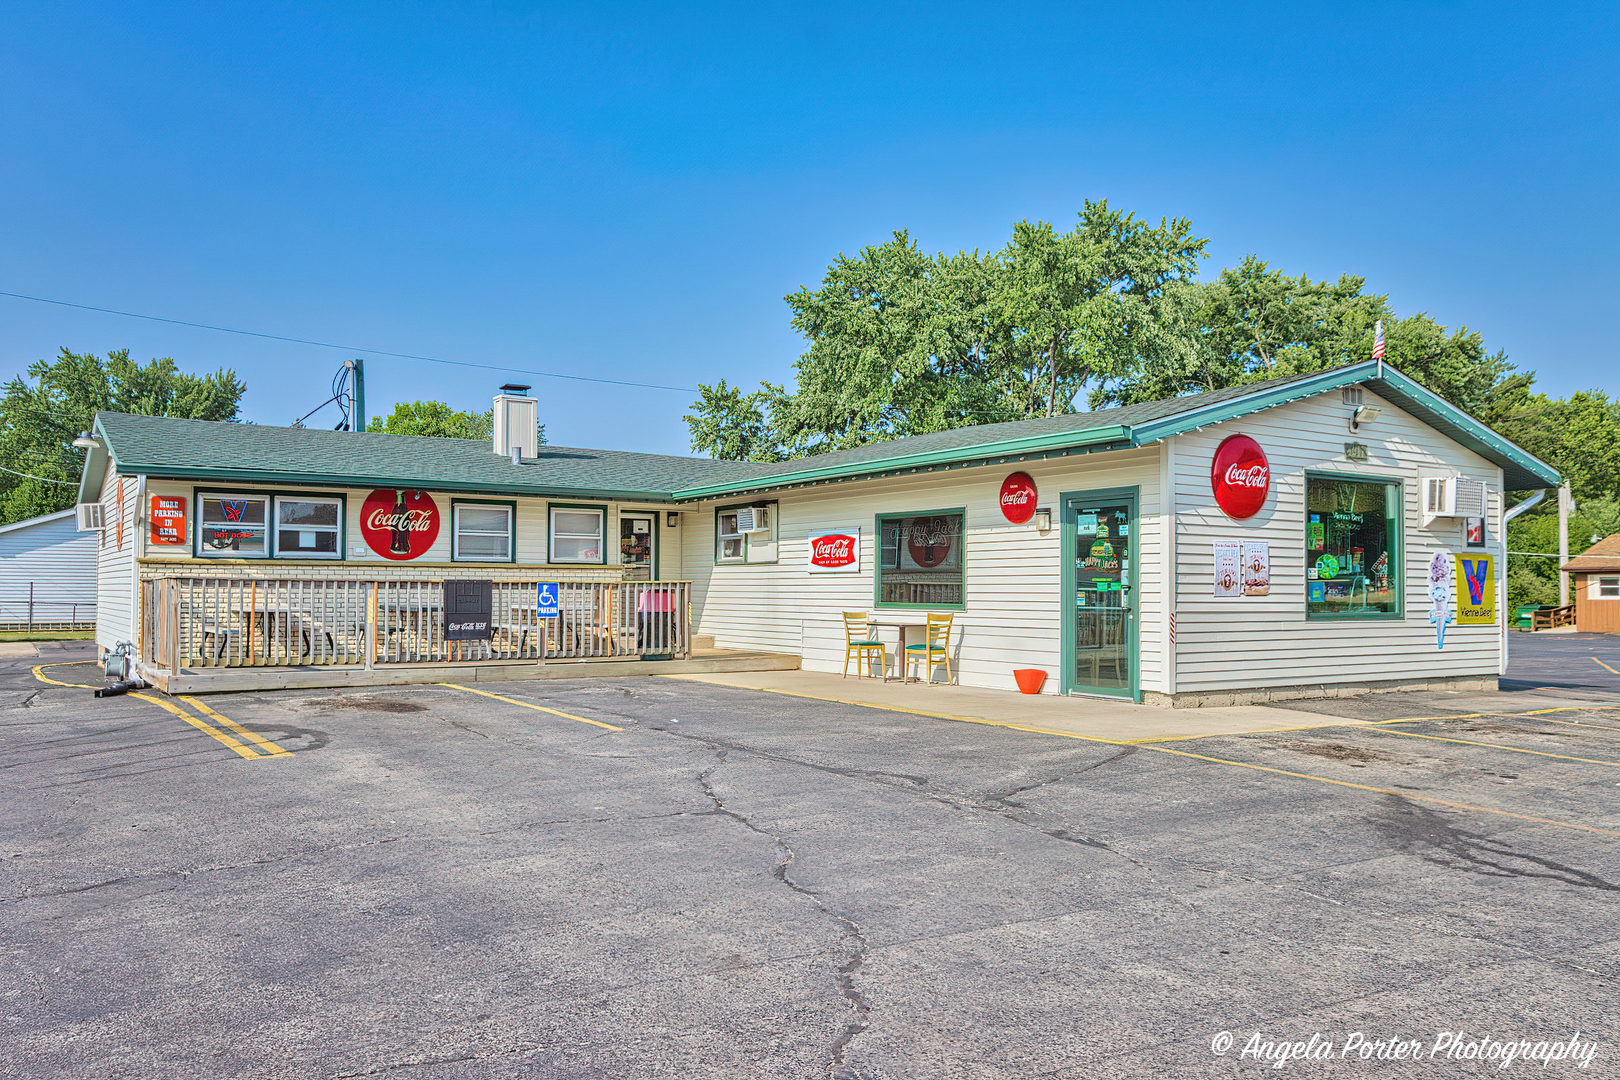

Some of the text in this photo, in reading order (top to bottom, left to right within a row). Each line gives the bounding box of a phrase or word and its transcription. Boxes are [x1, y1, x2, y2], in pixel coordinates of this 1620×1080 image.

[1225, 463, 1267, 488] Coca-Cola
[1001, 490, 1030, 506] Coca-Cola
[154, 510, 183, 518] PARKING
[366, 508, 433, 533] Coca-Cola
[164, 519, 173, 527] IN
[159, 528, 177, 536] REAR
[889, 523, 927, 542] Happy
[815, 539, 850, 559] Coca-Cola
[538, 606, 558, 614] PARKING
[1460, 606, 1479, 618] Vienna
[1479, 607, 1492, 620] Beef
